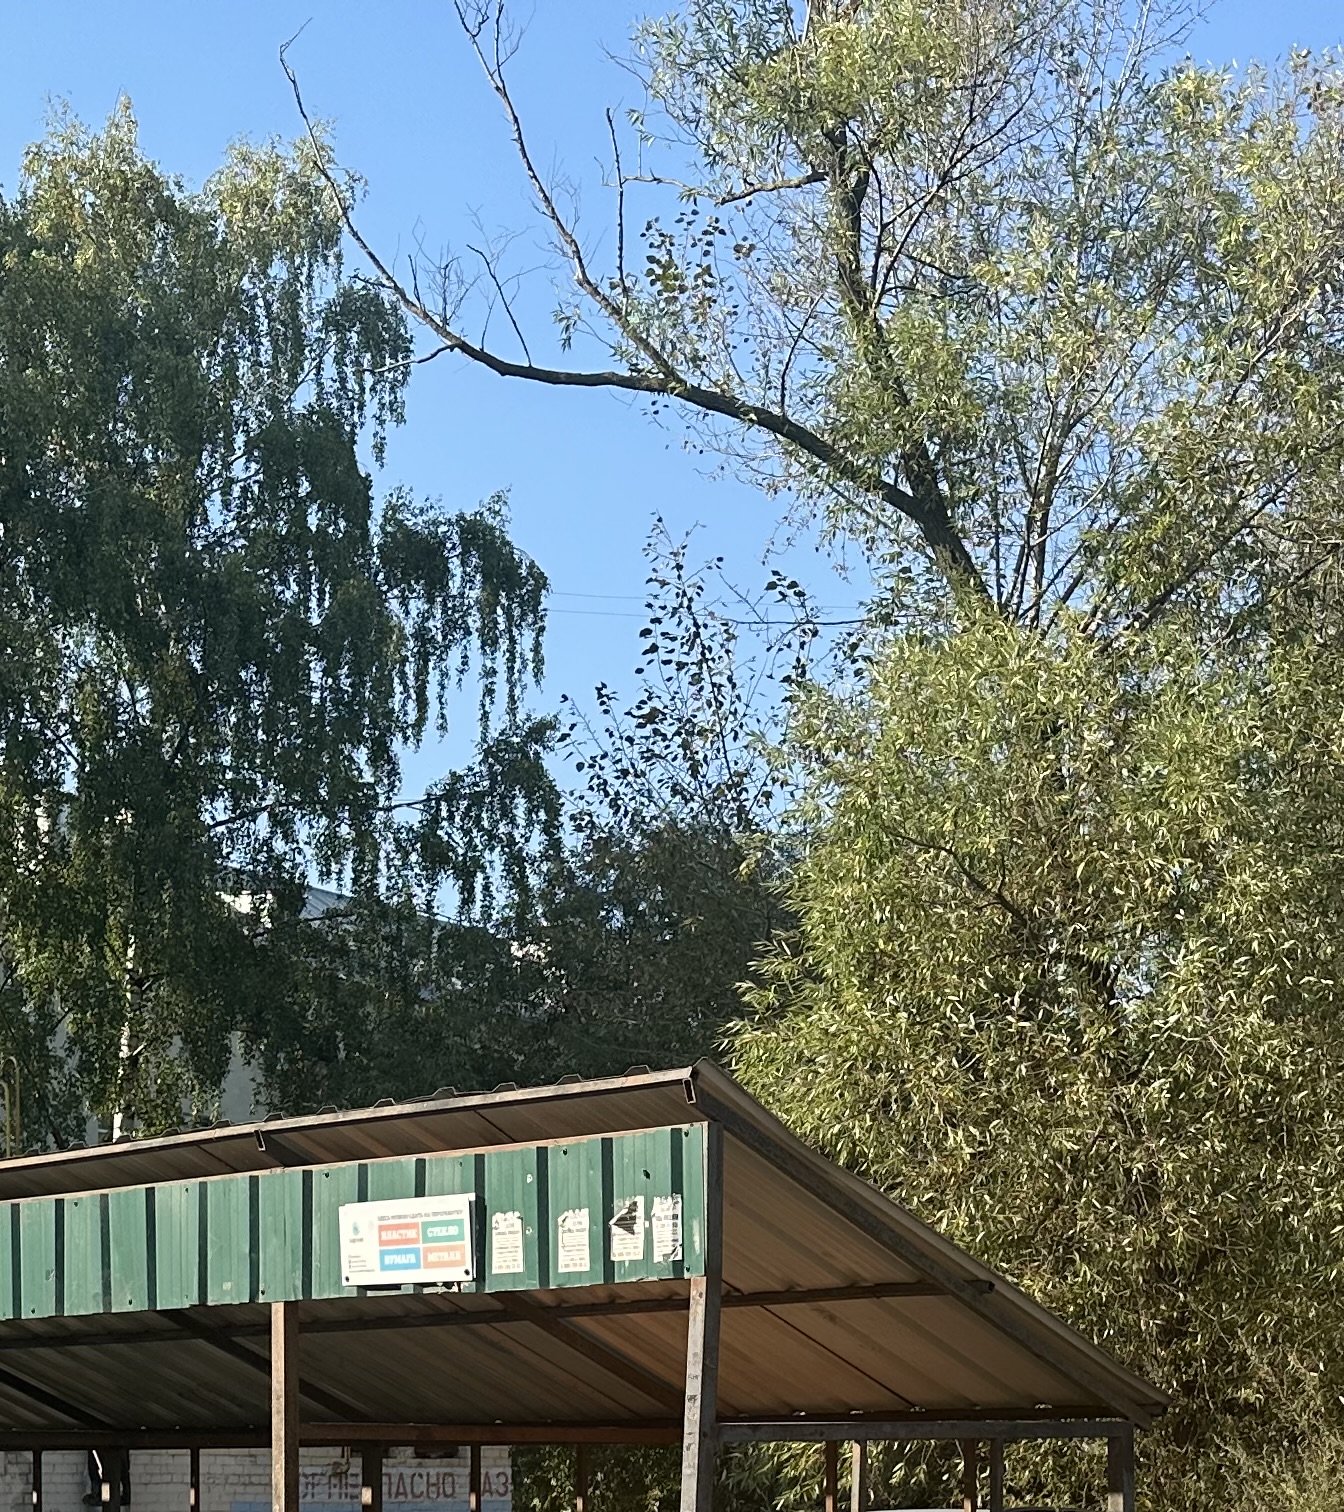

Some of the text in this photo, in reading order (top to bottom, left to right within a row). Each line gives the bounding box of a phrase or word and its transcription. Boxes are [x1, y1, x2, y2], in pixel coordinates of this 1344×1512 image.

[380, 1228, 418, 1241] ПЛАСТИК
[426, 1225, 459, 1238] СТЕКЛО
[384, 1253, 417, 1265] БУМАГА
[468, 1470, 510, 1498] АЗ
